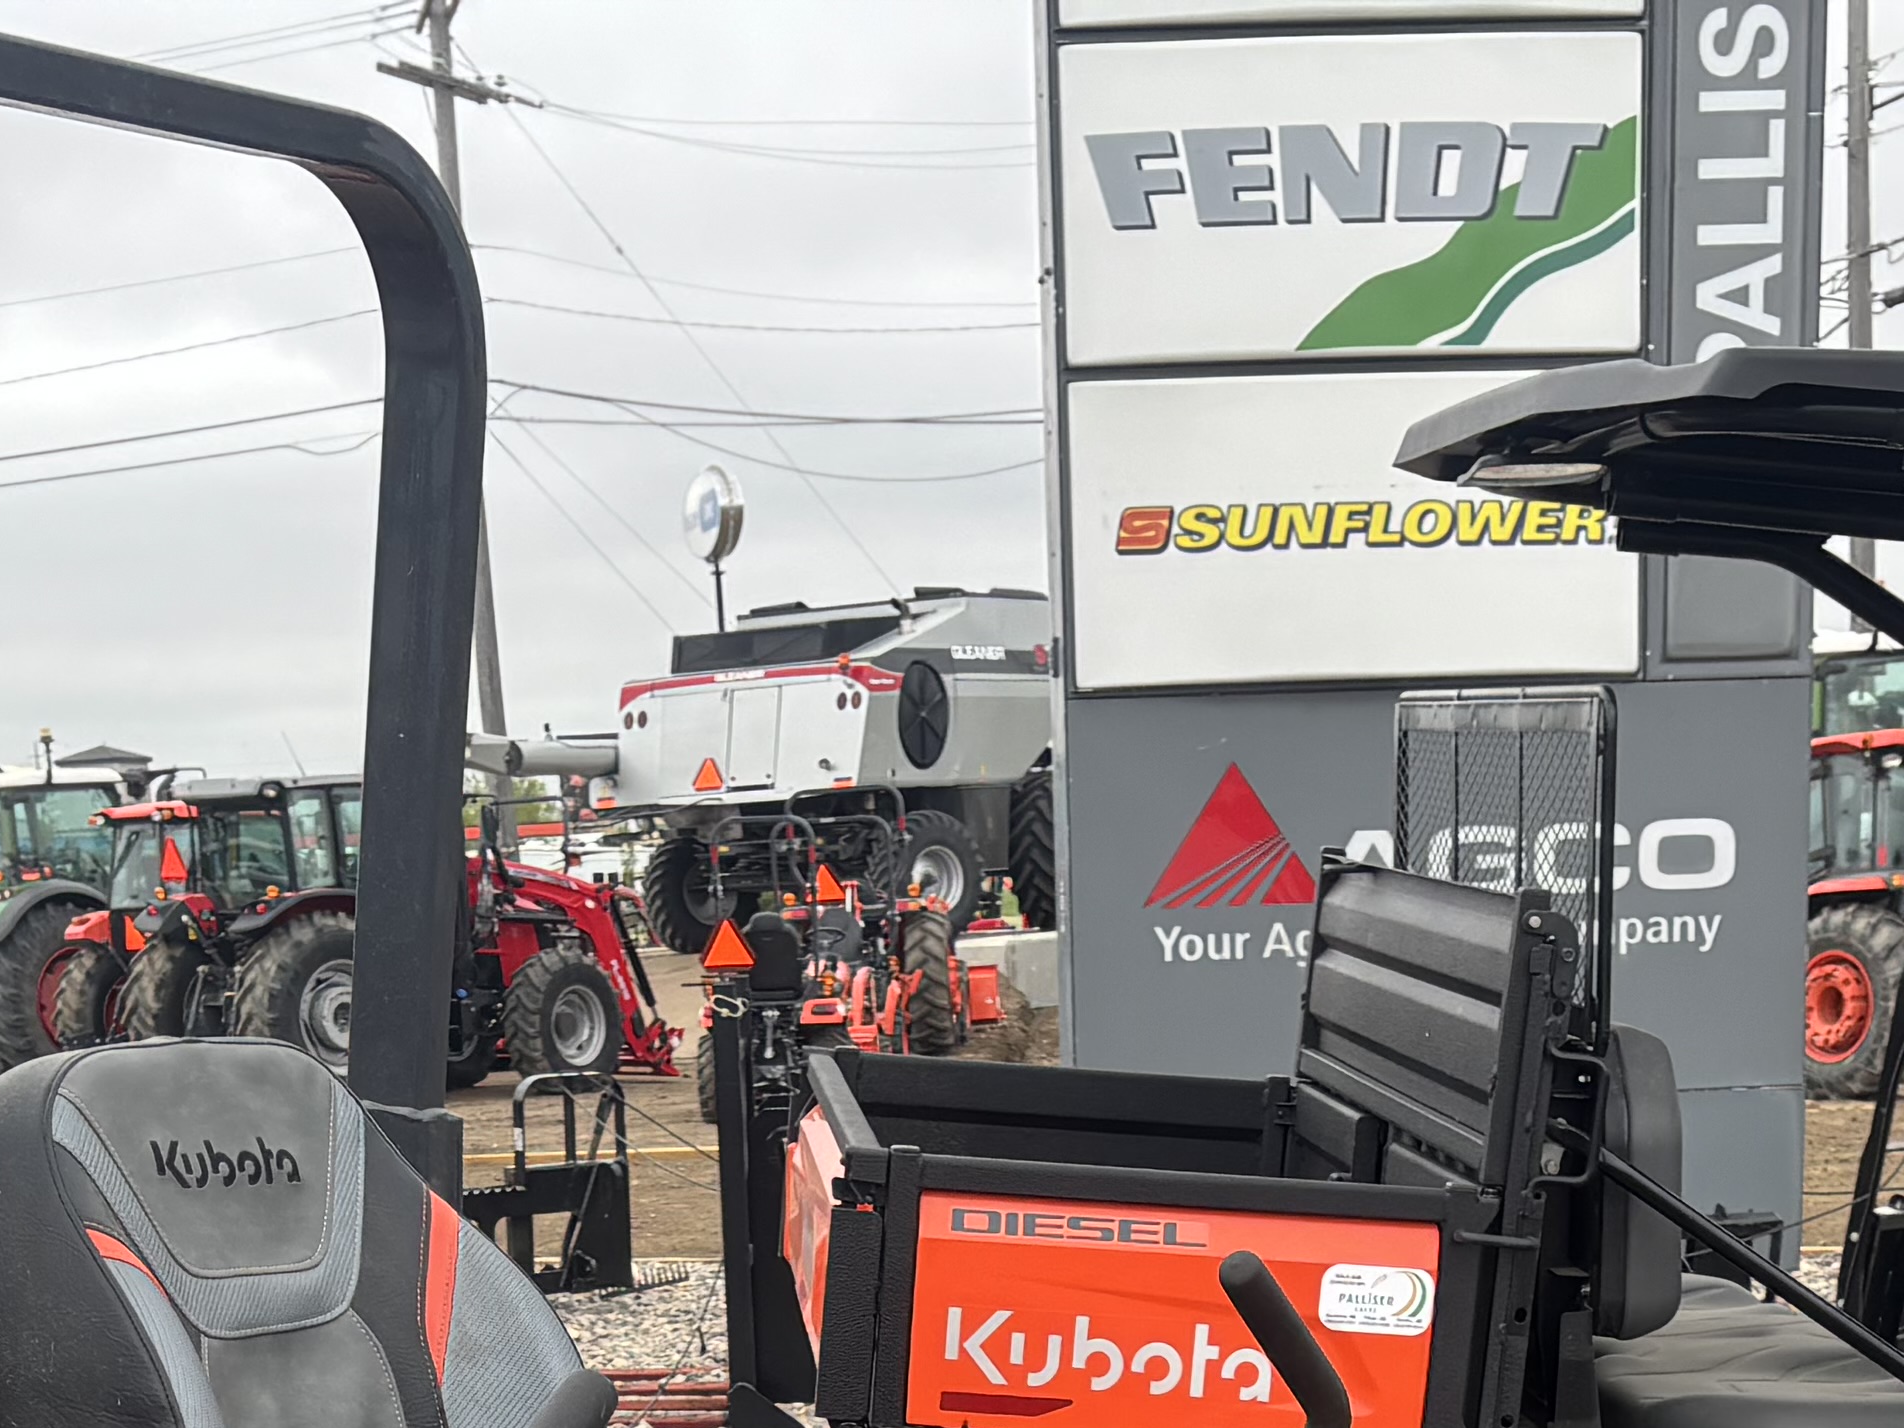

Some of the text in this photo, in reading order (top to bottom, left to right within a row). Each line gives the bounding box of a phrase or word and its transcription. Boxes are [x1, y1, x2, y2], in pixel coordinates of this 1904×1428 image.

[1083, 121, 1611, 229] FENDT
[1172, 498, 1608, 554] SUNFLOWER
[1152, 922, 1252, 962] Your
[149, 1135, 304, 1193] Kubota
[950, 1206, 1208, 1249] DIESEL
[943, 1305, 1272, 1404] Kubota
